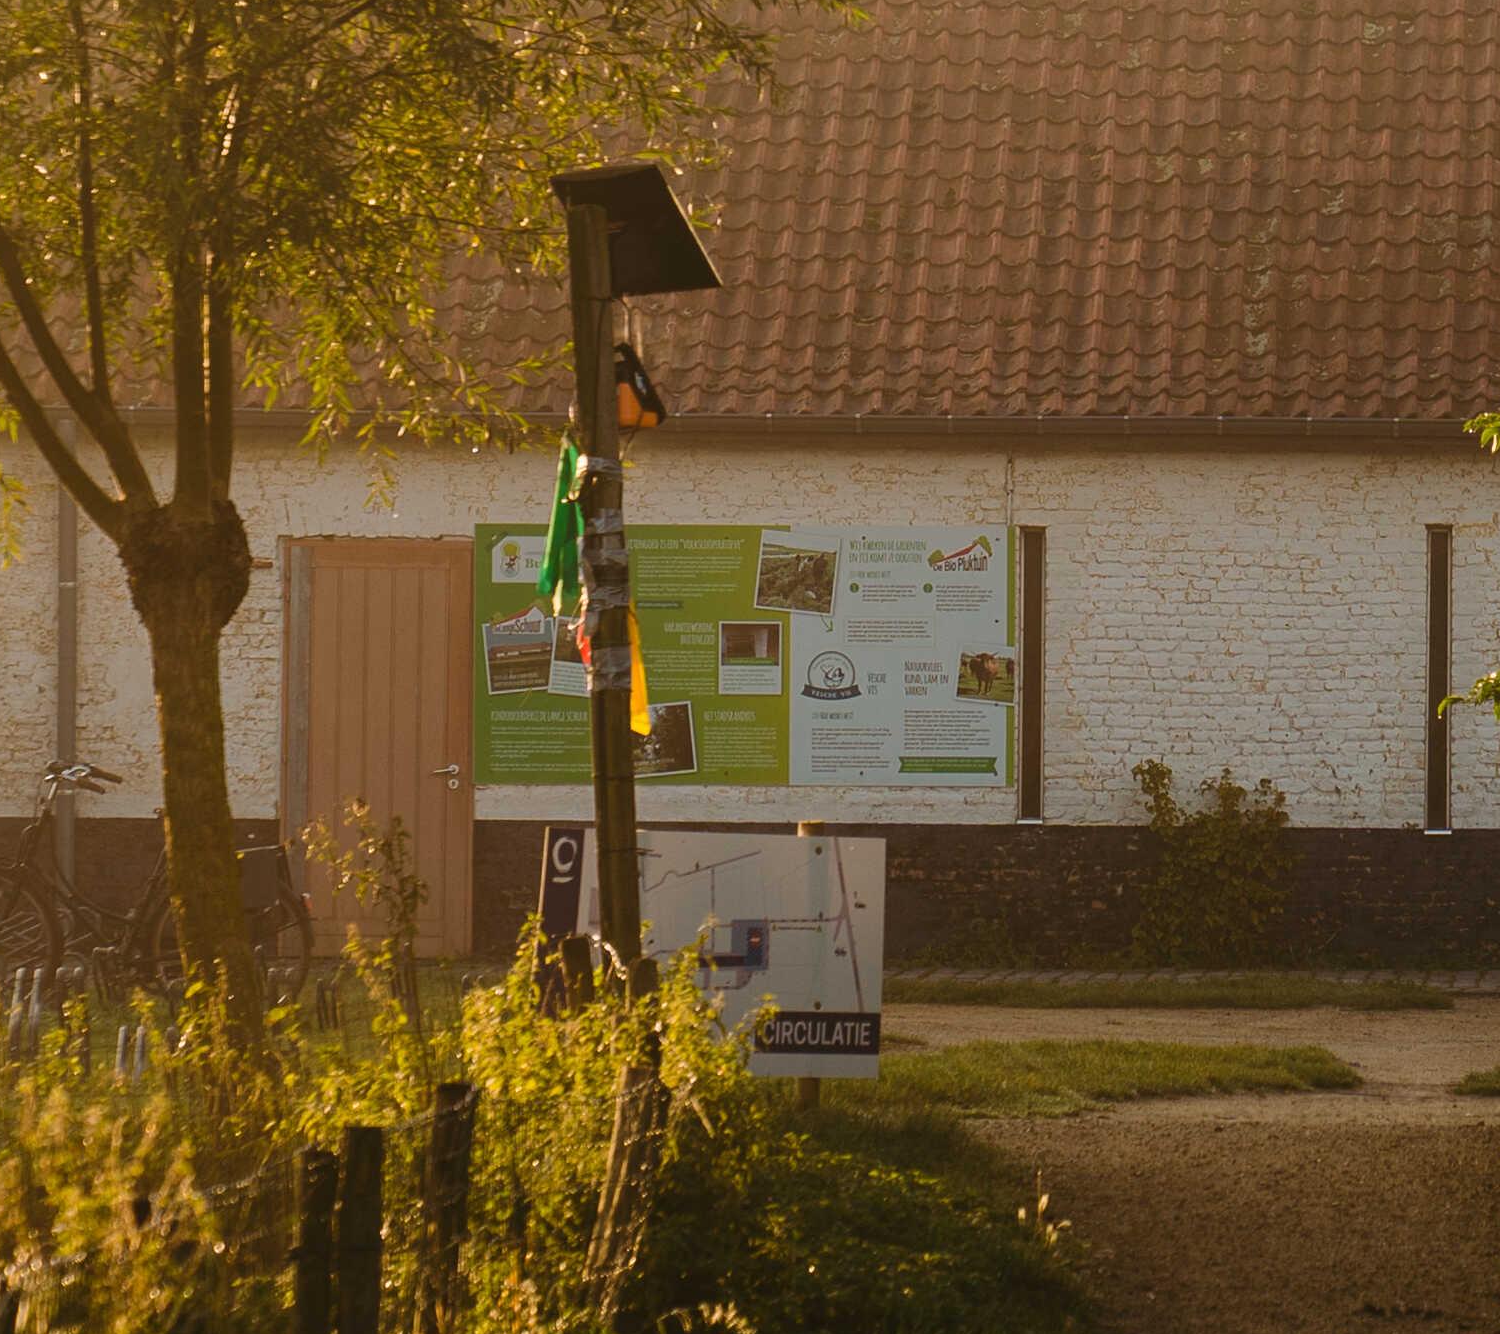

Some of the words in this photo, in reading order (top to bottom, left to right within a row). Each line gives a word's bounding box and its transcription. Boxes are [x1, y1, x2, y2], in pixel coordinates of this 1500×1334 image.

[958, 552, 989, 572] Pluktuin
[924, 673, 938, 684] LAM
[940, 673, 949, 684] EN
[762, 1020, 871, 1046] CIRCULATIE
